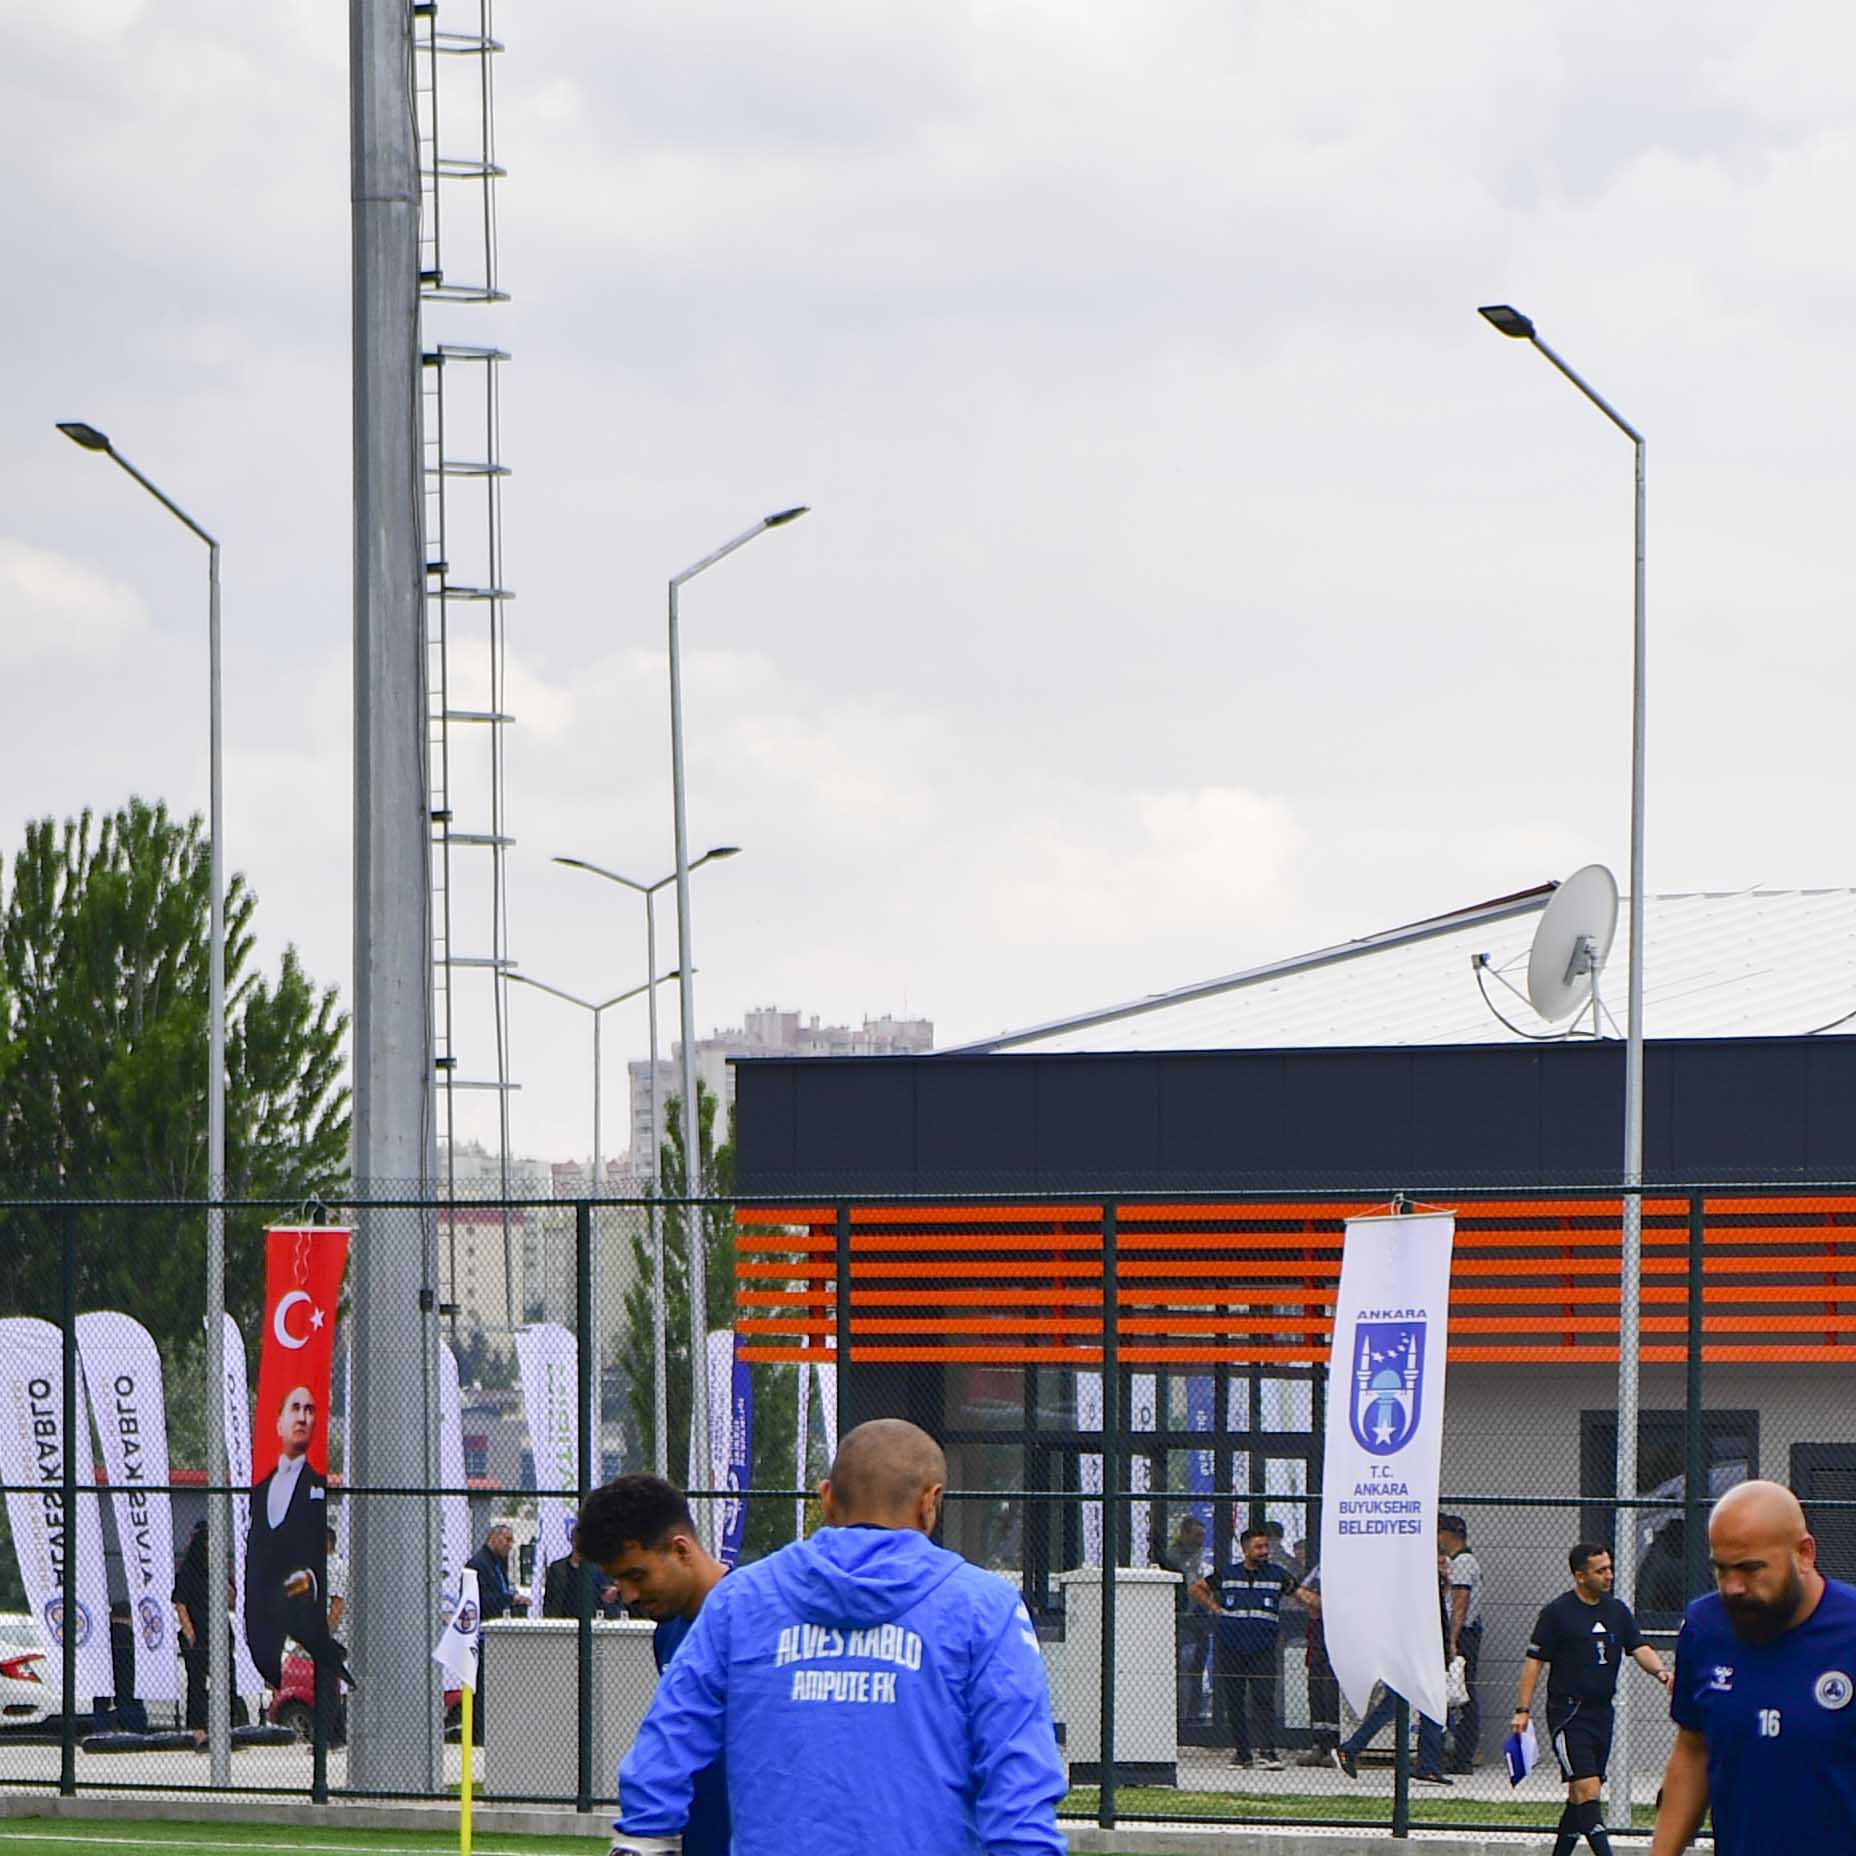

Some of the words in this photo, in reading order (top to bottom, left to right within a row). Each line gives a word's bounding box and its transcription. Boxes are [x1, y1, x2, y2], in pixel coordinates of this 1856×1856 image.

[1357, 1309, 1427, 1319] ANKARA
[1370, 1465, 1394, 1479] T.C.
[1353, 1483, 1409, 1496] ANKARA
[775, 1623, 845, 1668] ALVES
[847, 1623, 923, 1672] KABLO
[792, 1670, 870, 1703] AMPUTE
[871, 1671, 898, 1704] FK
[1758, 1709, 1782, 1738] 16
